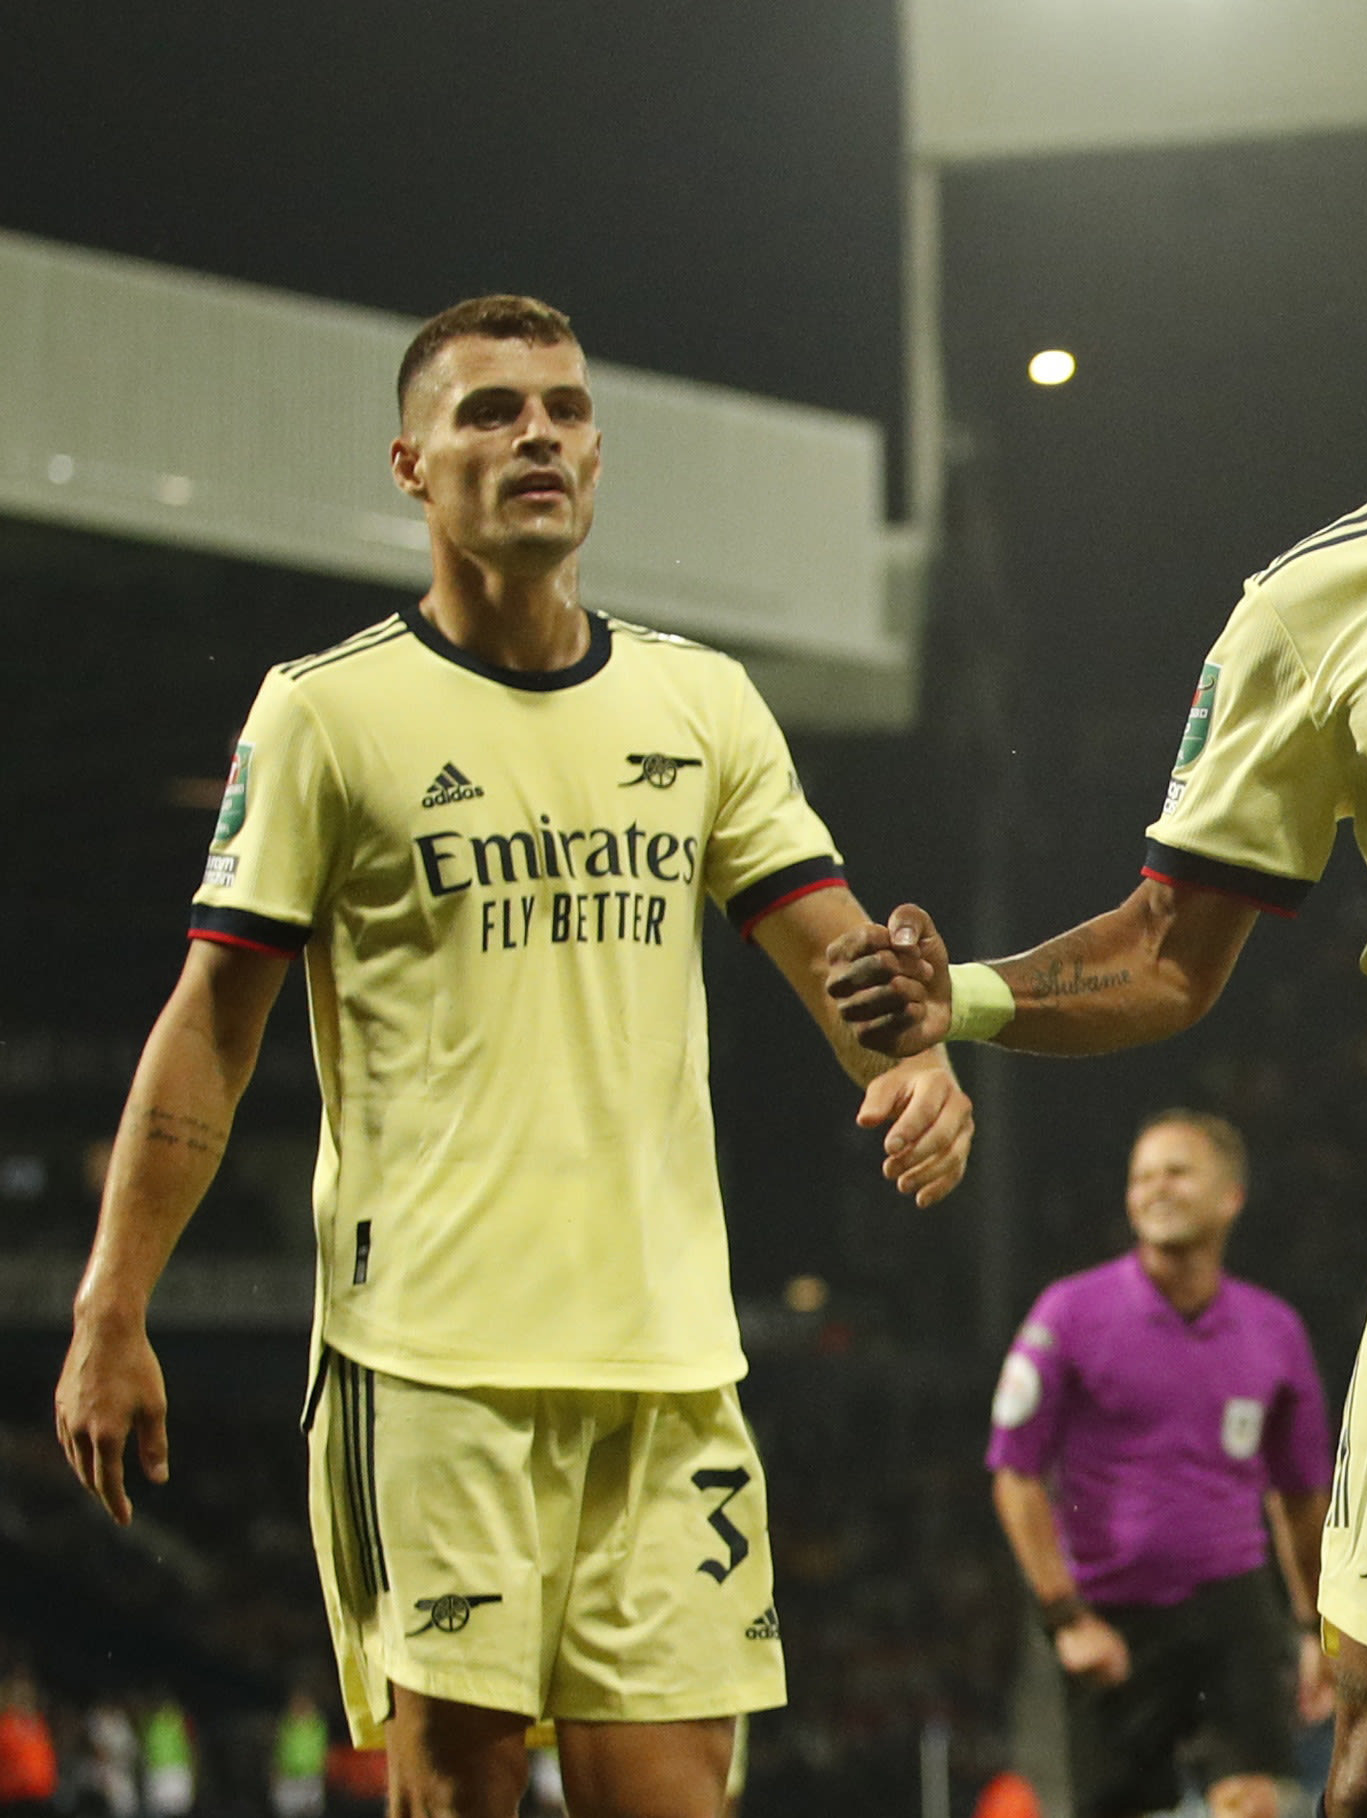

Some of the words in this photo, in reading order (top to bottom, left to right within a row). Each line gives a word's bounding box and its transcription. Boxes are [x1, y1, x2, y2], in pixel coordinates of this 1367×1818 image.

[421, 784, 485, 809] adidas
[414, 813, 699, 898] Emirates
[482, 896, 536, 953] FLY
[552, 891, 667, 947] BETTER
[691, 1466, 751, 1586] 3
